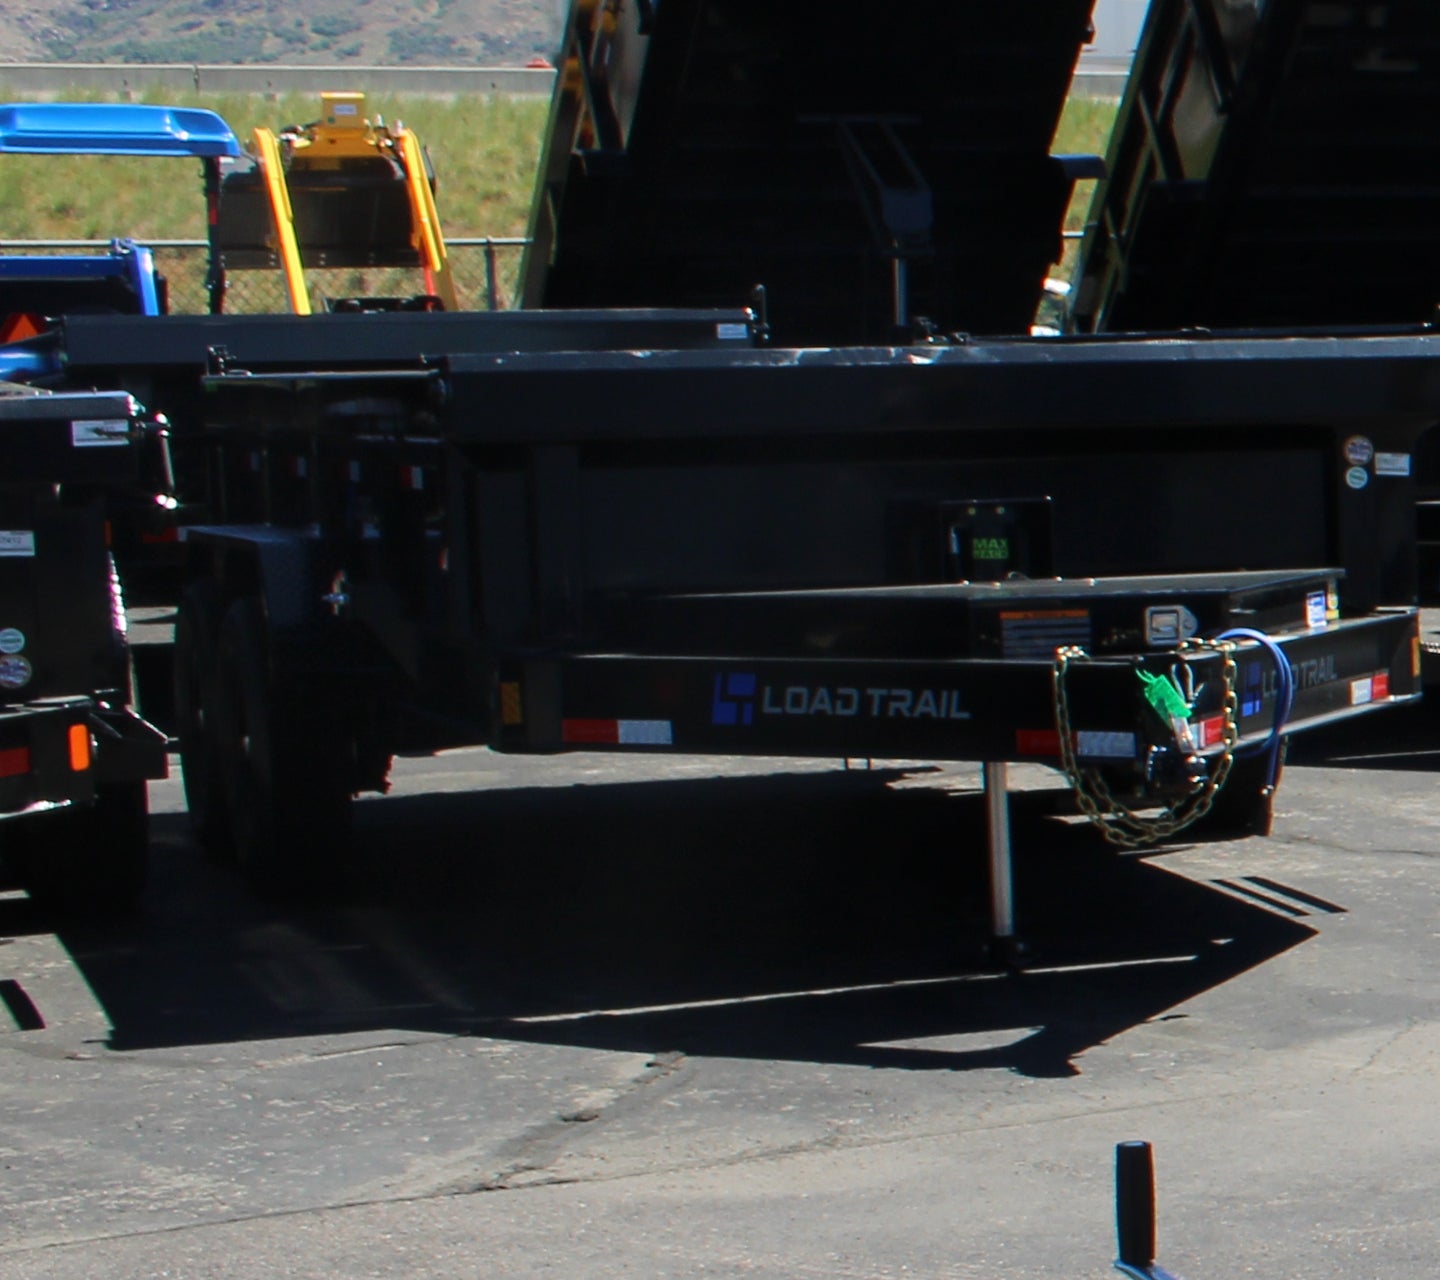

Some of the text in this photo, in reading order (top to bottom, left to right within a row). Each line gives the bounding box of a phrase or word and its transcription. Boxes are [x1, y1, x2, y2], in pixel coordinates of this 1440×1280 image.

[972, 537, 1009, 551] MAX
[1300, 654, 1339, 689] TRAIL
[762, 685, 971, 720] LOAD TRAIL
